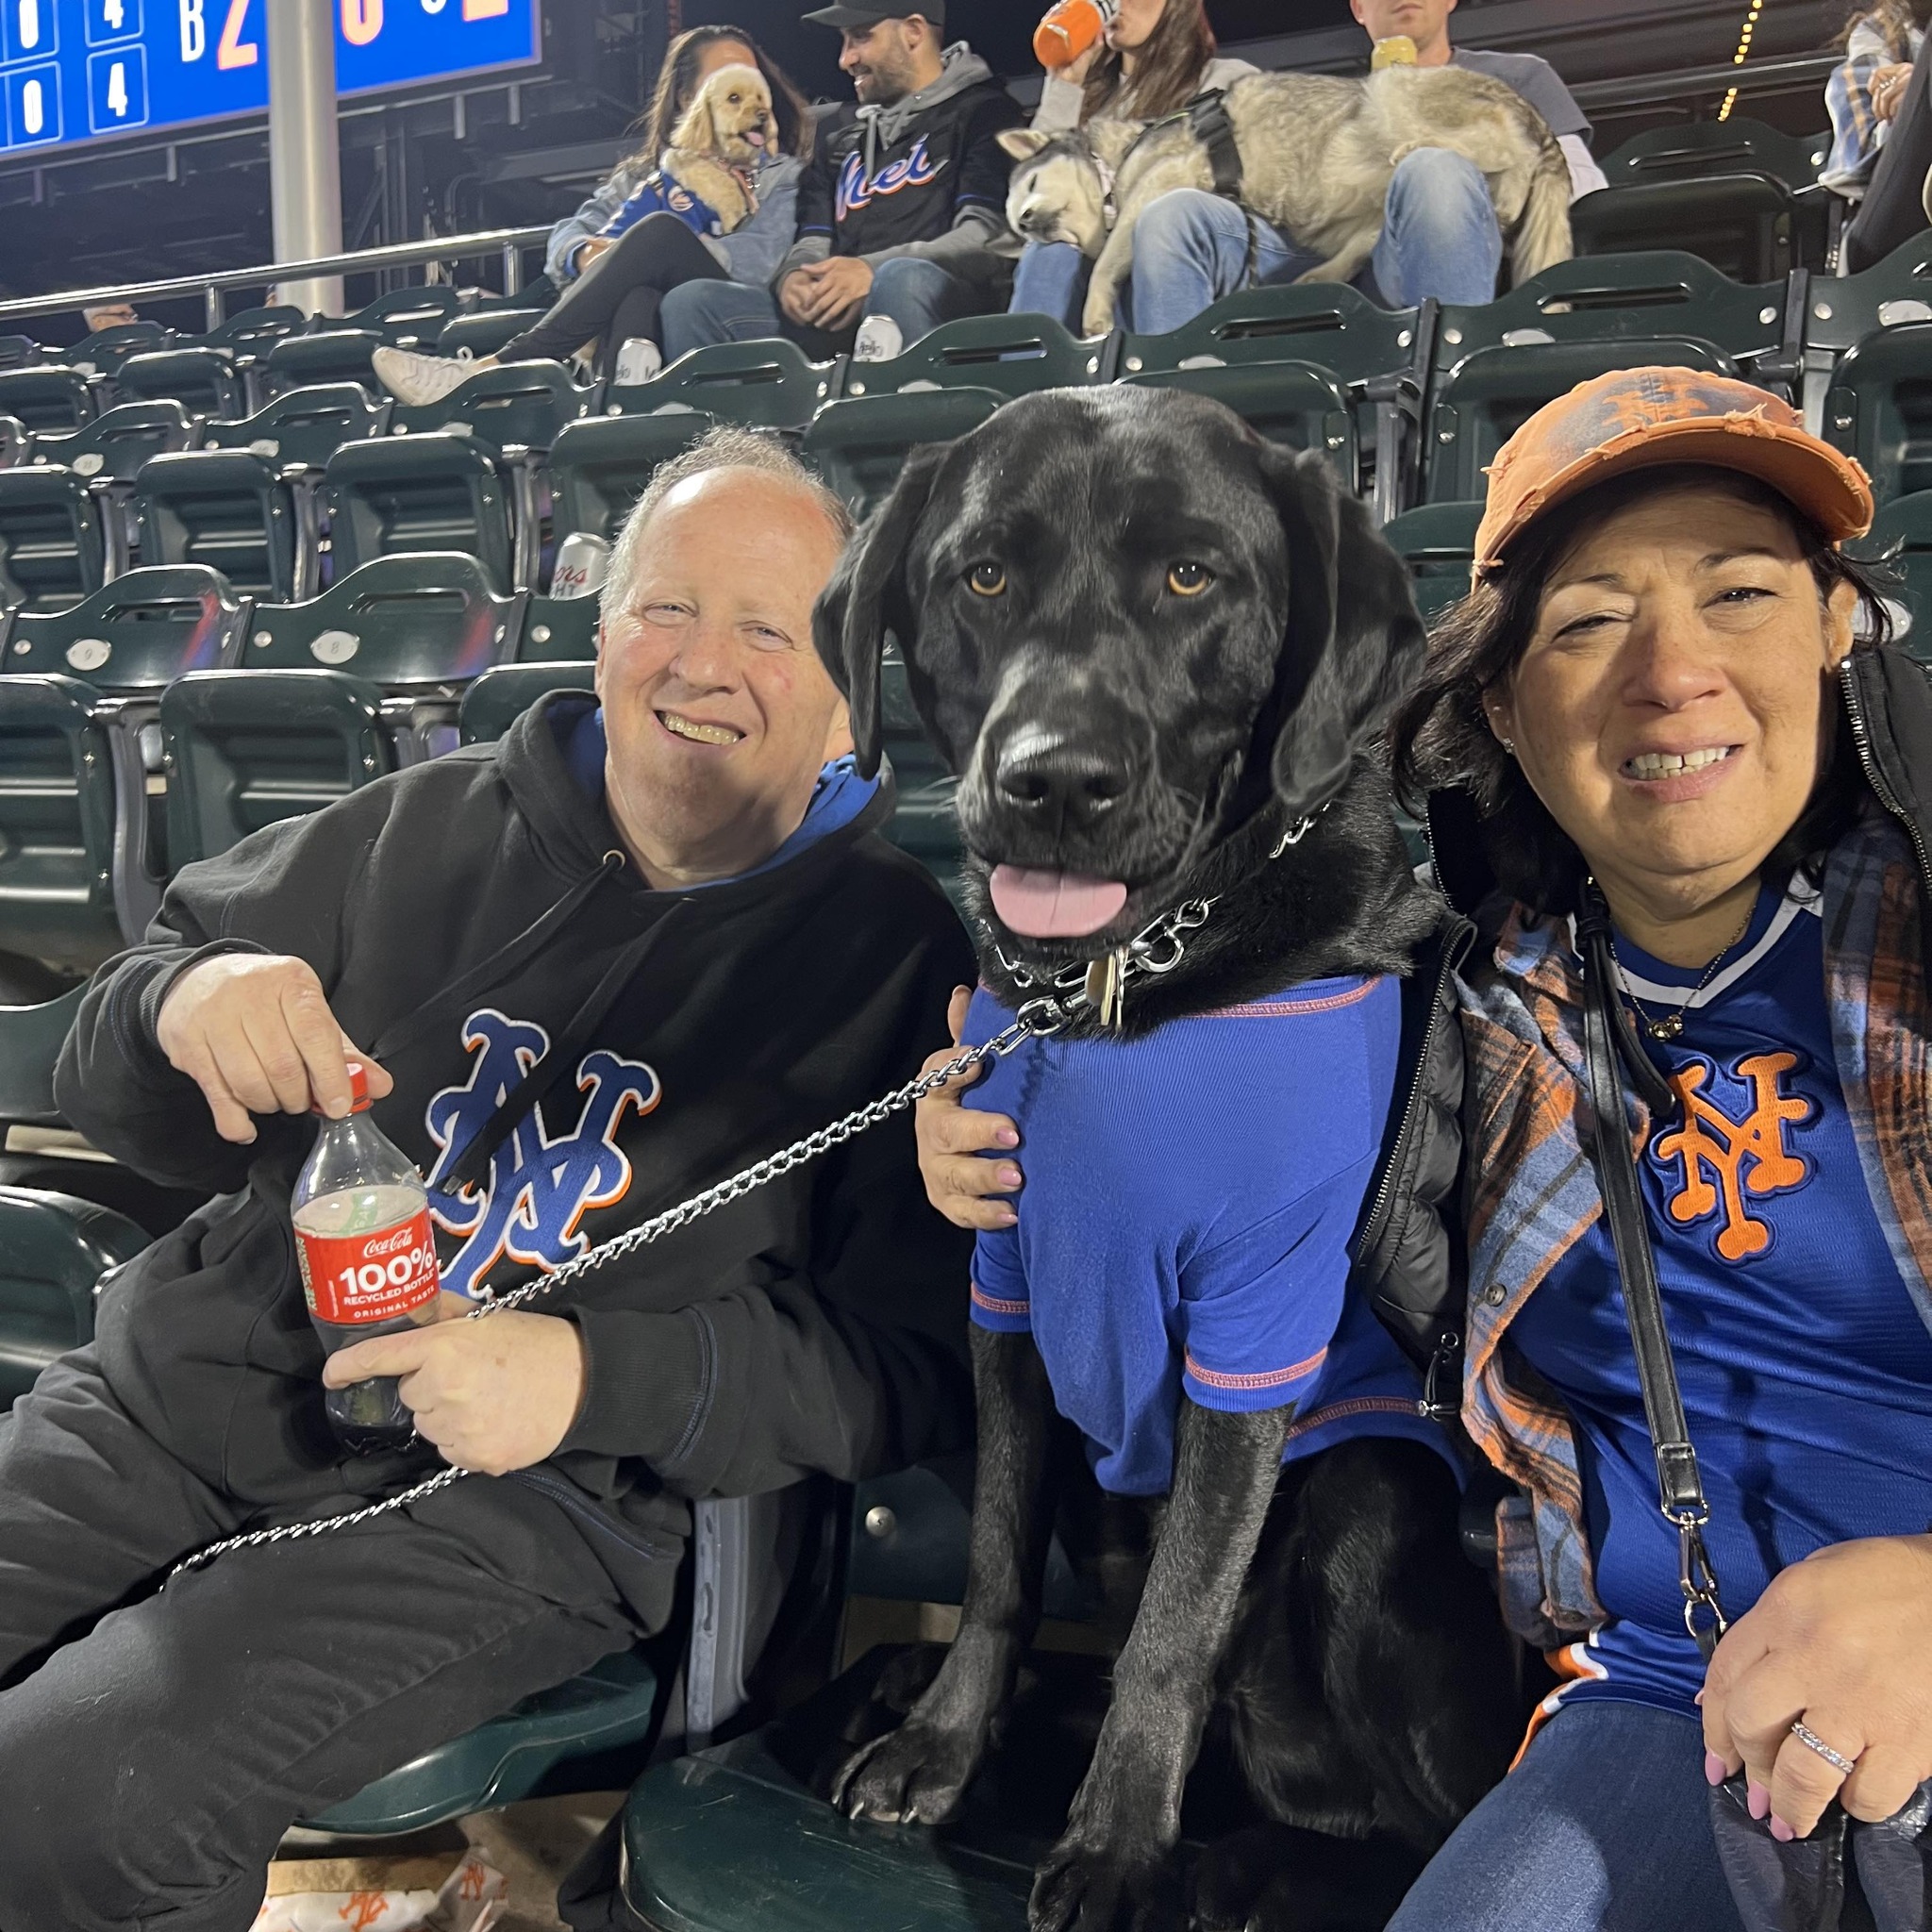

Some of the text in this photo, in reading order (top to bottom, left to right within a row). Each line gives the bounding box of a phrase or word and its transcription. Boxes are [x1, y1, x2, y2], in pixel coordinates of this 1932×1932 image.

[179, 0, 206, 62] B
[23, 61, 128, 134] 0 4
[425, 1007, 663, 1302] NY
[1657, 1050, 1810, 1262] NY
[339, 1240, 434, 1296] 100%
[363, 1226, 413, 1258] Coca-Cola
[343, 1287, 402, 1307] RECYCLED
[403, 1266, 435, 1294] BOTTLE
[353, 1283, 435, 1319] ORIGINAL TASTE
